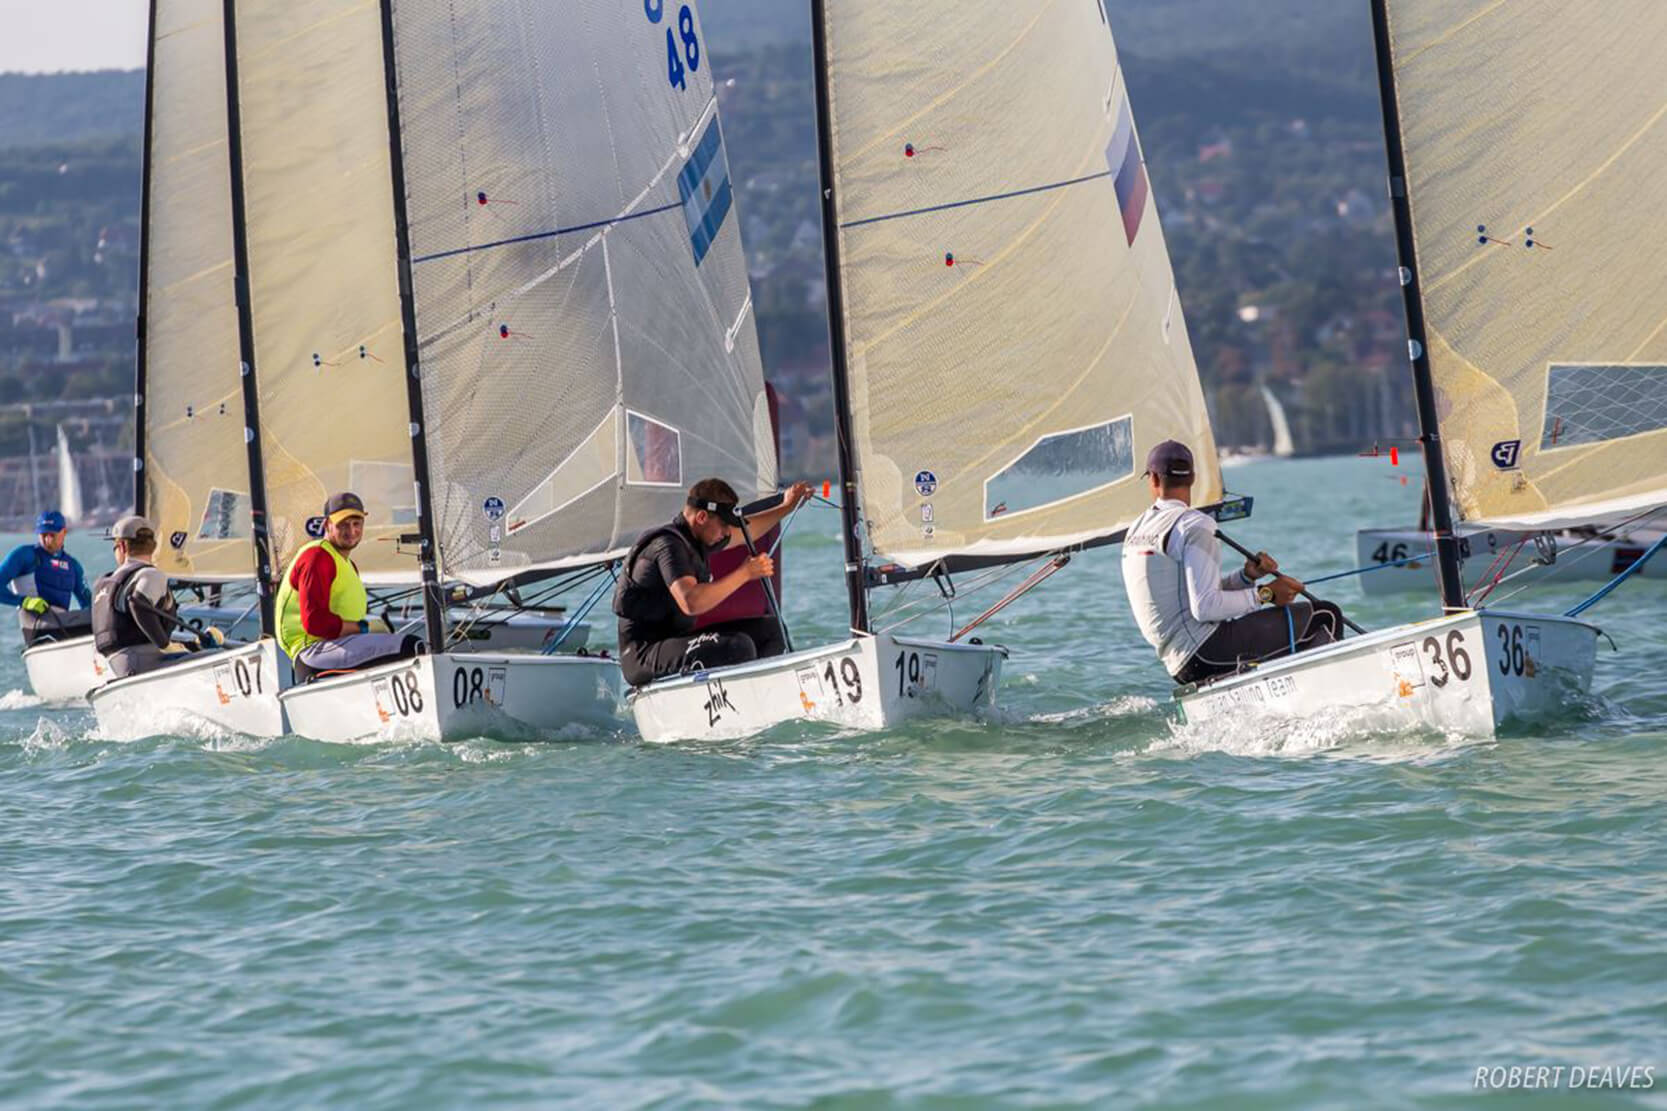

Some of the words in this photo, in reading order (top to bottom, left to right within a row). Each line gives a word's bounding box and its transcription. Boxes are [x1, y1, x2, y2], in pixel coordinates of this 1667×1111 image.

[666, 5, 699, 92] 48
[1371, 541, 1409, 568] 46
[895, 650, 920, 698] 19
[1423, 629, 1472, 689] 36
[1498, 624, 1524, 677] 36
[235, 653, 262, 698] 07
[391, 670, 424, 717] 08
[454, 666, 484, 710] 08
[824, 657, 863, 708] 19
[1262, 675, 1298, 699] Team
